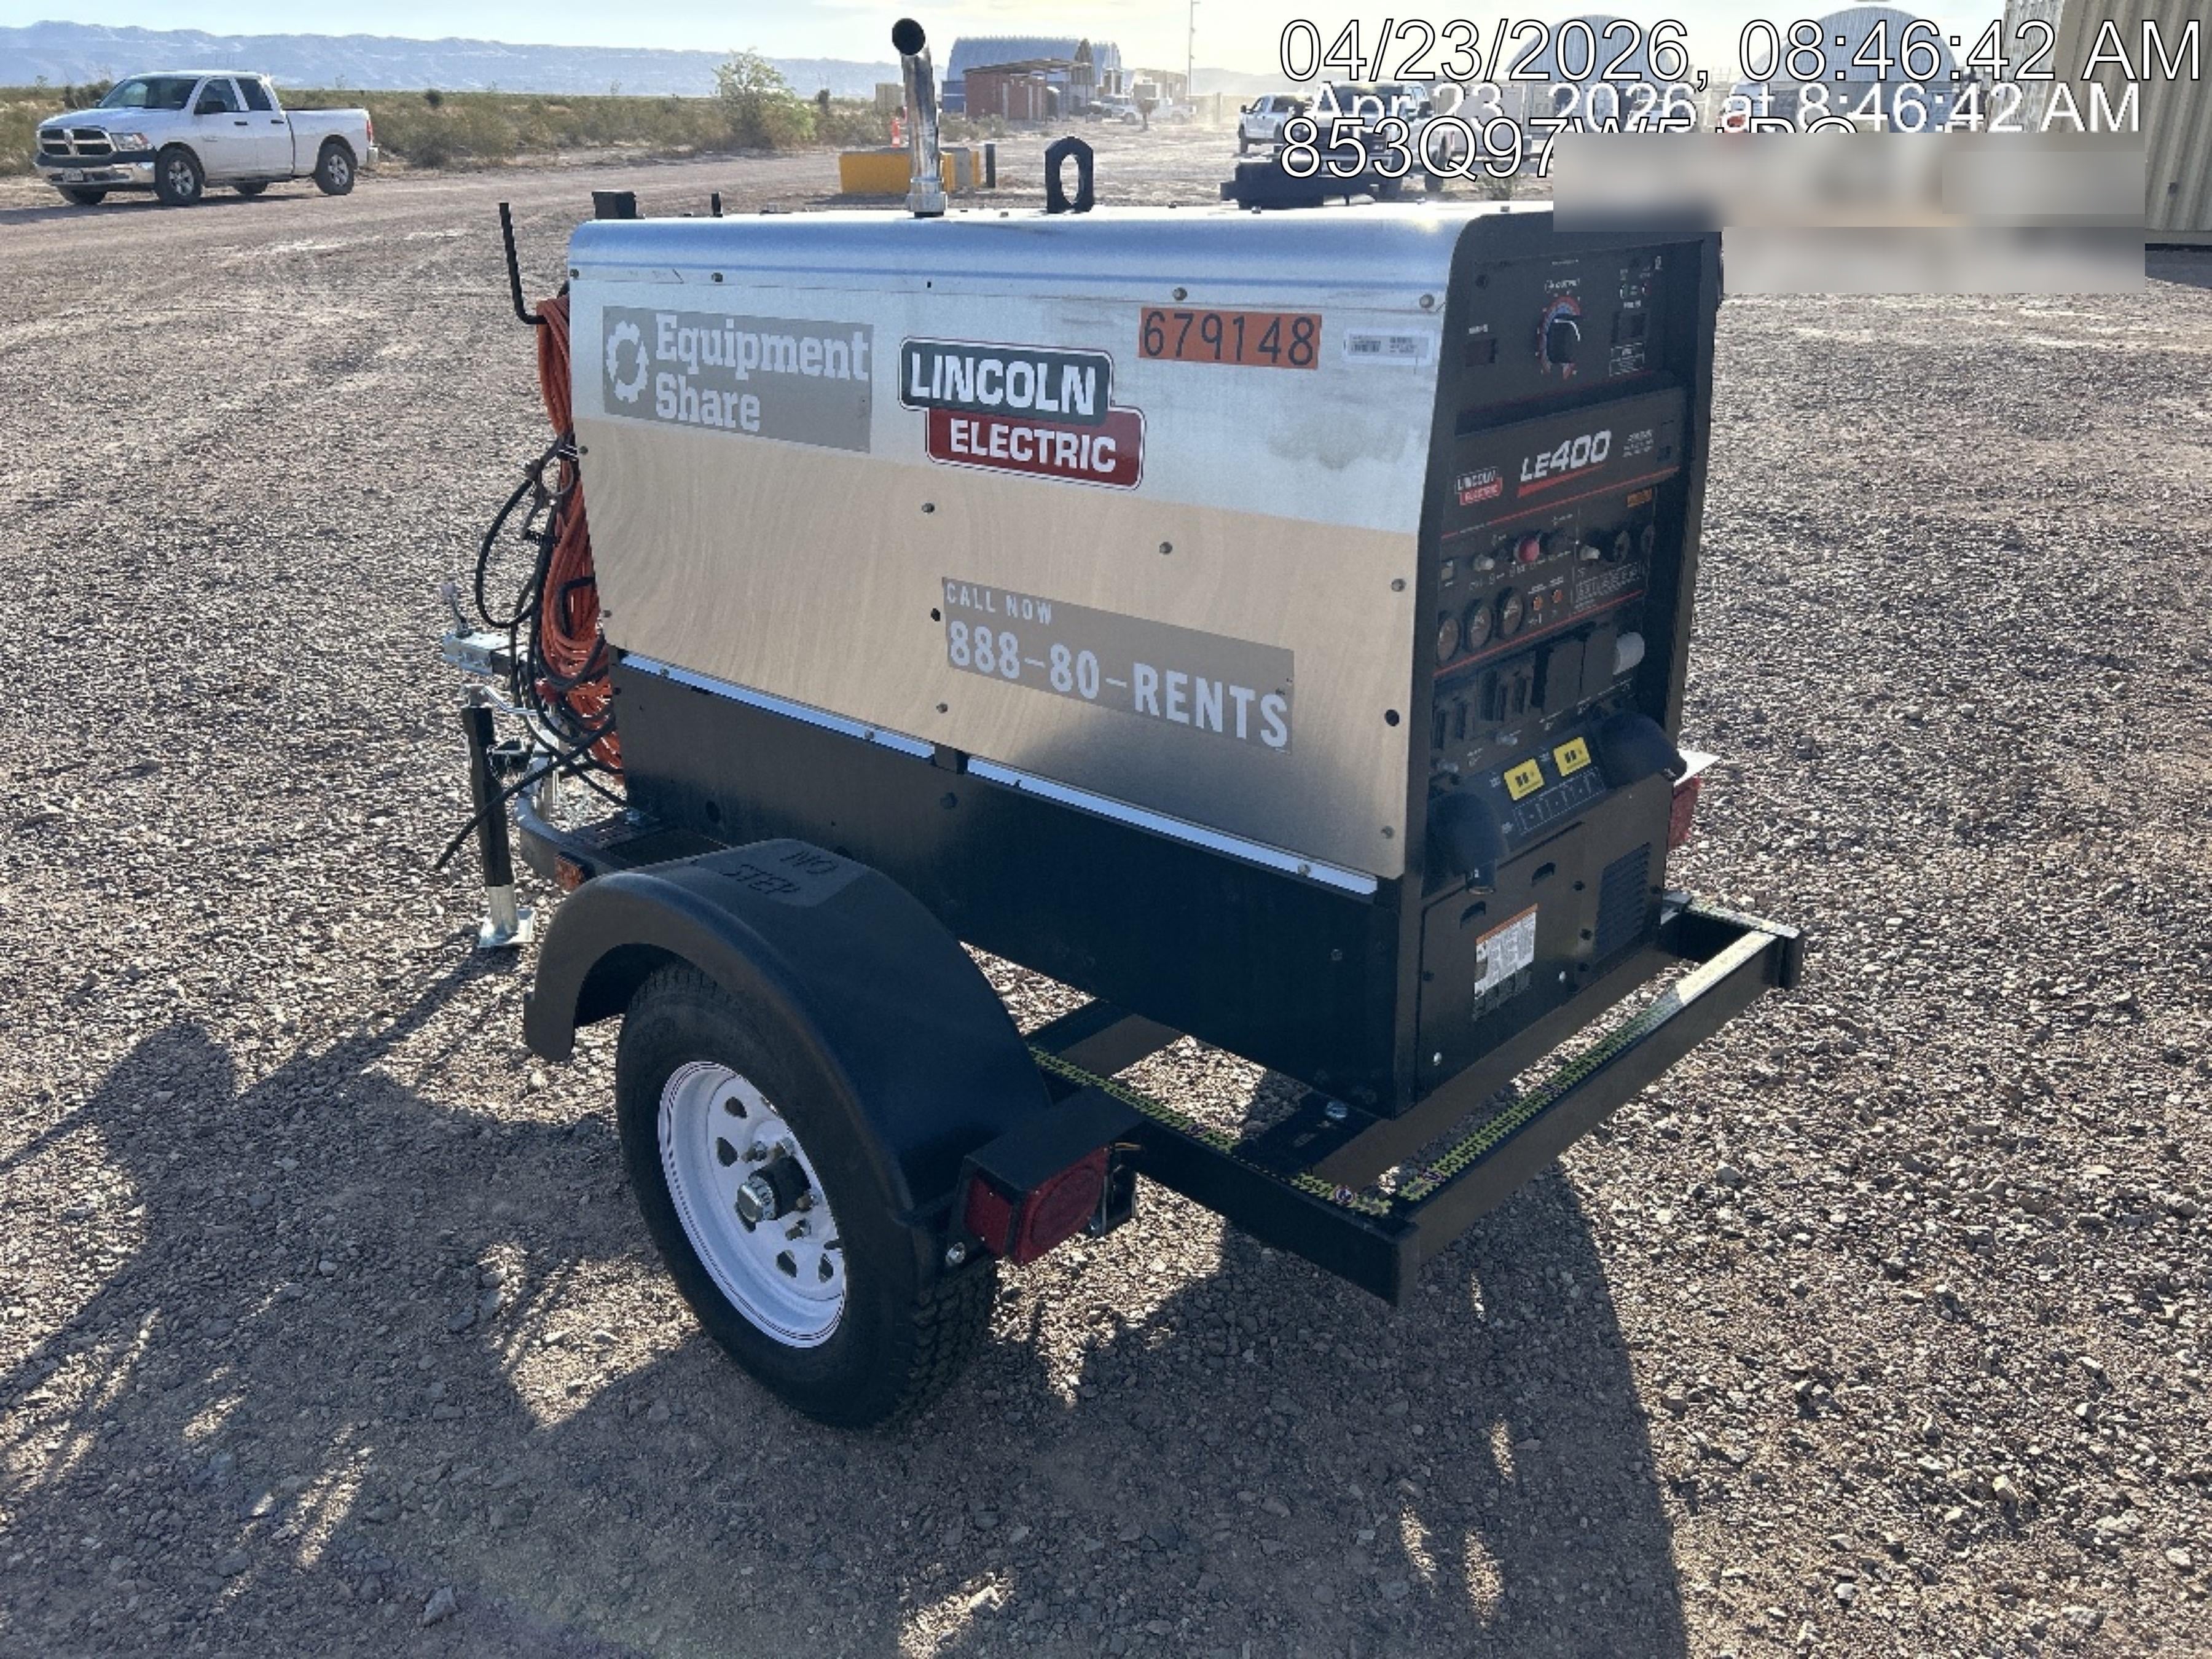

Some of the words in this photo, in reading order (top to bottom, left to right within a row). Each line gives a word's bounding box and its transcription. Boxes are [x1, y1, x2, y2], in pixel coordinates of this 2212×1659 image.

[656, 313, 869, 380] Equipment
[1143, 310, 1314, 366] 679148
[656, 372, 760, 431] Share
[911, 352, 1096, 415] LINCOLN
[951, 418, 1116, 472] ELECTRIC
[1520, 429, 1612, 482] LE400
[946, 582, 996, 613] CALL
[1006, 595, 1051, 626] NOW
[949, 621, 1288, 748] 888-80-RENTS
[718, 863, 801, 895] STEP
[779, 850, 839, 875] NO
